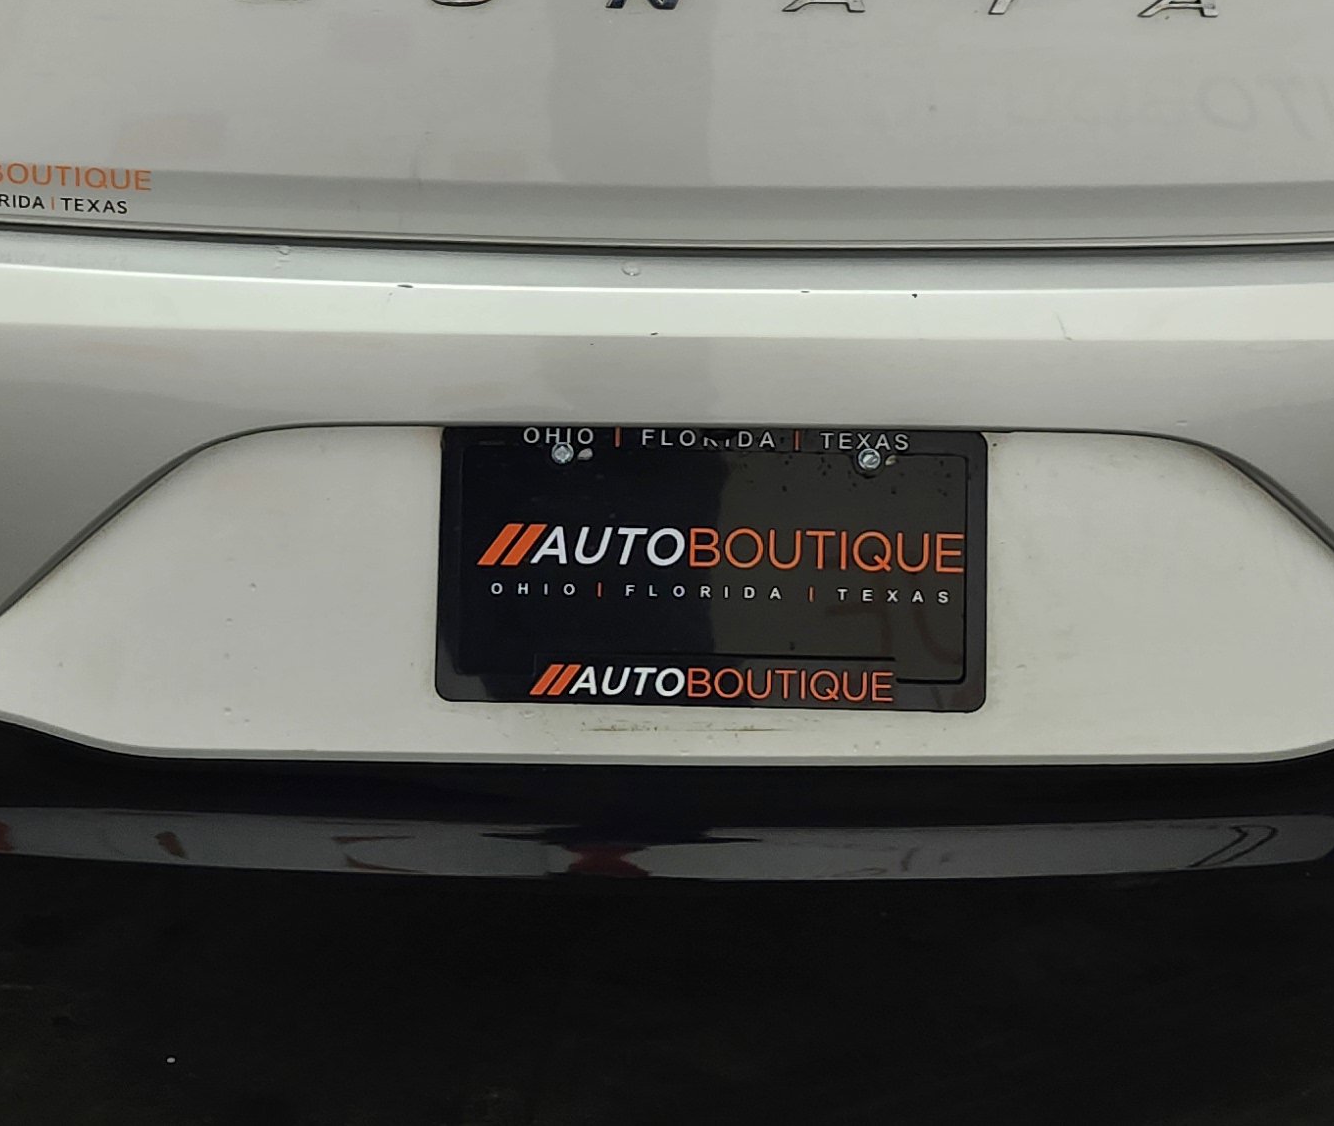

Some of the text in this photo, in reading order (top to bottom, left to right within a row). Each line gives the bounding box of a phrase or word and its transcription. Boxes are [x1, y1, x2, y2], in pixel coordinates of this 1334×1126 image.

[60, 197, 128, 215] TEXAS
[522, 426, 595, 446] OHIO
[820, 432, 910, 451] TEXAS
[529, 525, 965, 574] AUTOBOUTIQUE
[490, 582, 950, 605] OHIO FLORIDA TEXAS
[568, 665, 894, 703] AUTOBOUTIQUE
